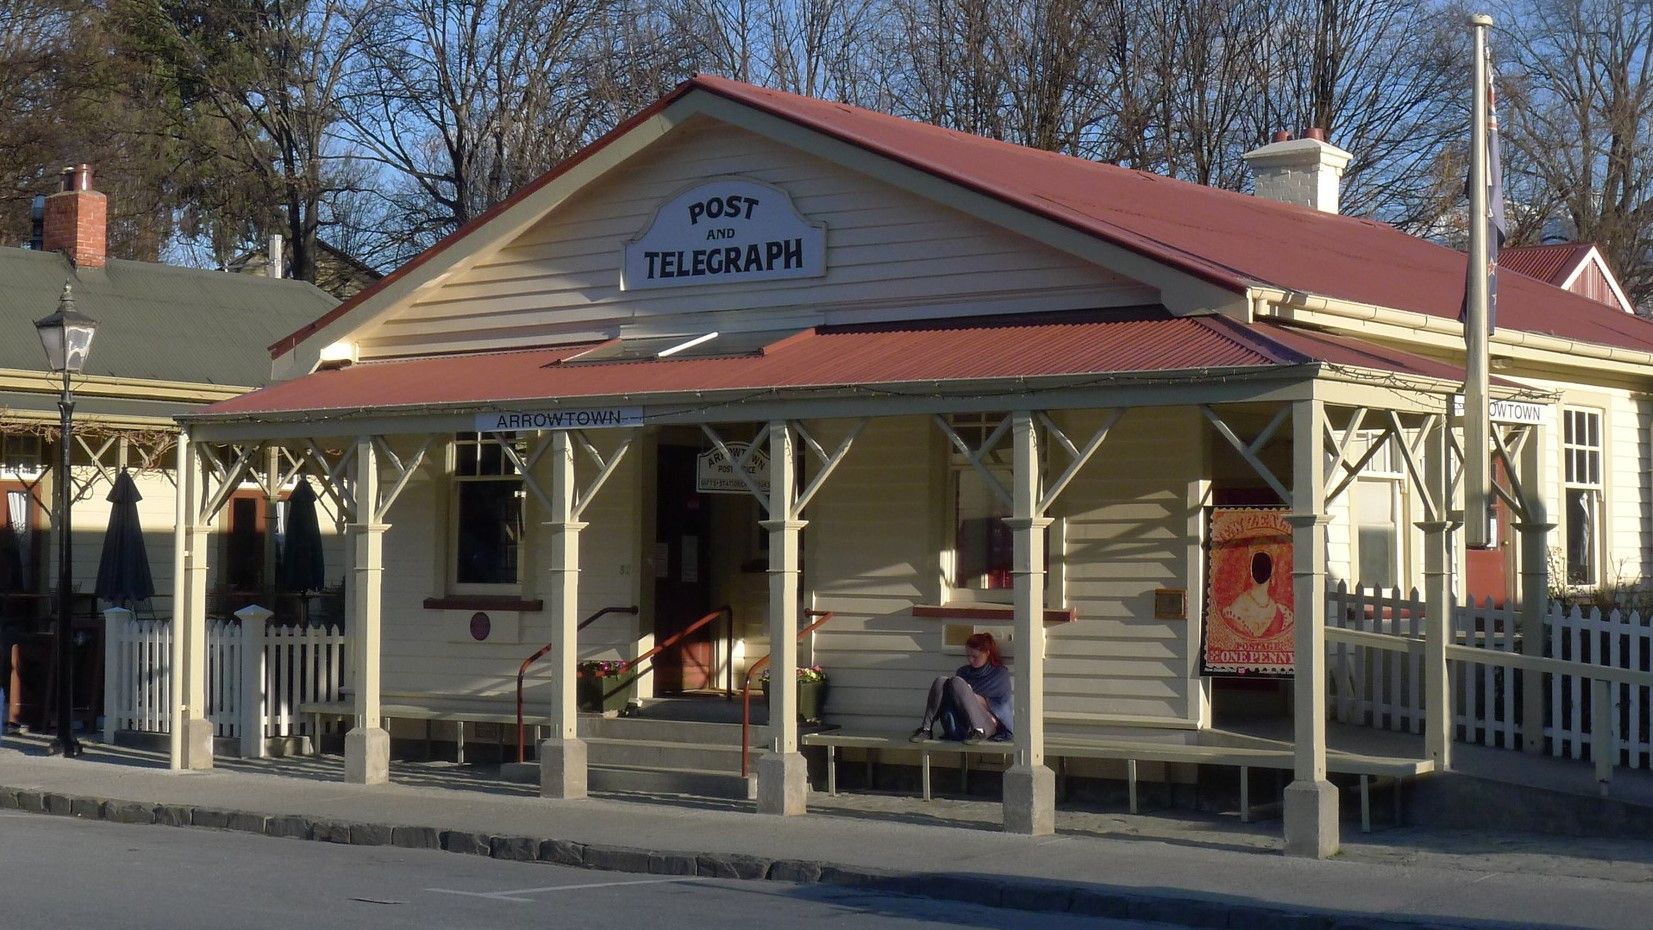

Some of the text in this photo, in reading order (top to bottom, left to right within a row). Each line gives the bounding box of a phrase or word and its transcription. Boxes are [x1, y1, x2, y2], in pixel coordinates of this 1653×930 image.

[688, 196, 759, 225] POST
[706, 228, 735, 240] AND
[644, 238, 803, 279] TELEGRAPH
[497, 410, 621, 428] ARROWTOWN
[1489, 403, 1540, 420] OWTOWN
[1221, 650, 1297, 664] ONE PENNY
